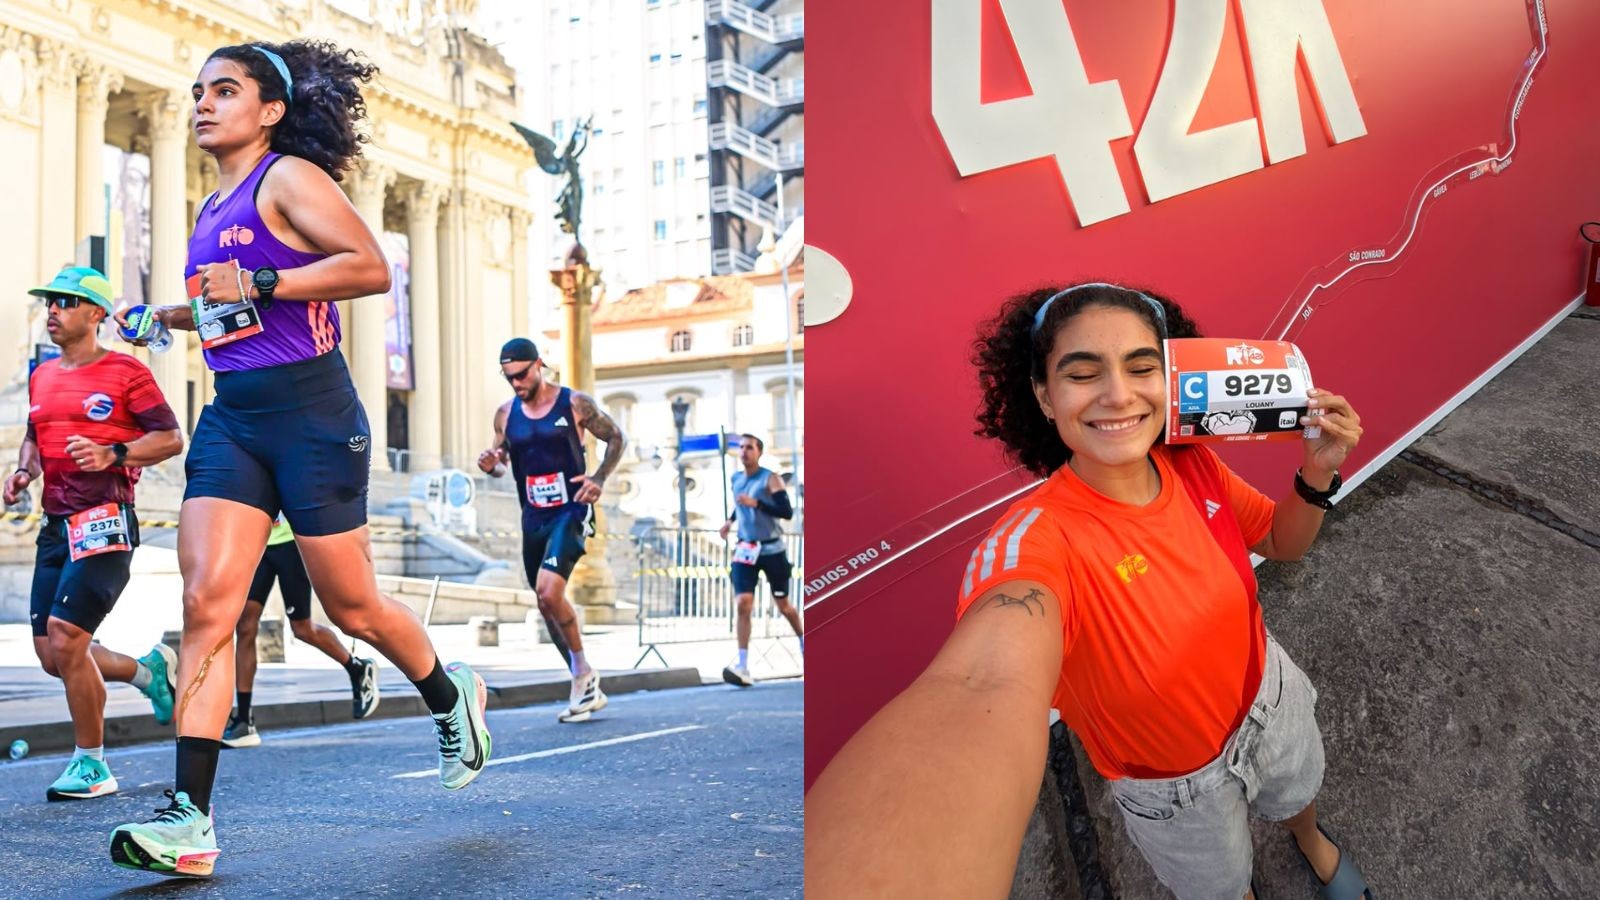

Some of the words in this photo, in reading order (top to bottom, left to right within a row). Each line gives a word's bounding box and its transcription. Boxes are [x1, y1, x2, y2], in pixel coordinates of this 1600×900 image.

[1361, 248, 1386, 260] CONRADO
[1184, 376, 1205, 400] C
[1225, 373, 1293, 397] 9279
[1245, 401, 1275, 409] LOUANY
[90, 518, 121, 532] 2376
[847, 547, 879, 570] PRO
[880, 540, 892, 551] 4
[80, 768, 101, 785] FILA
